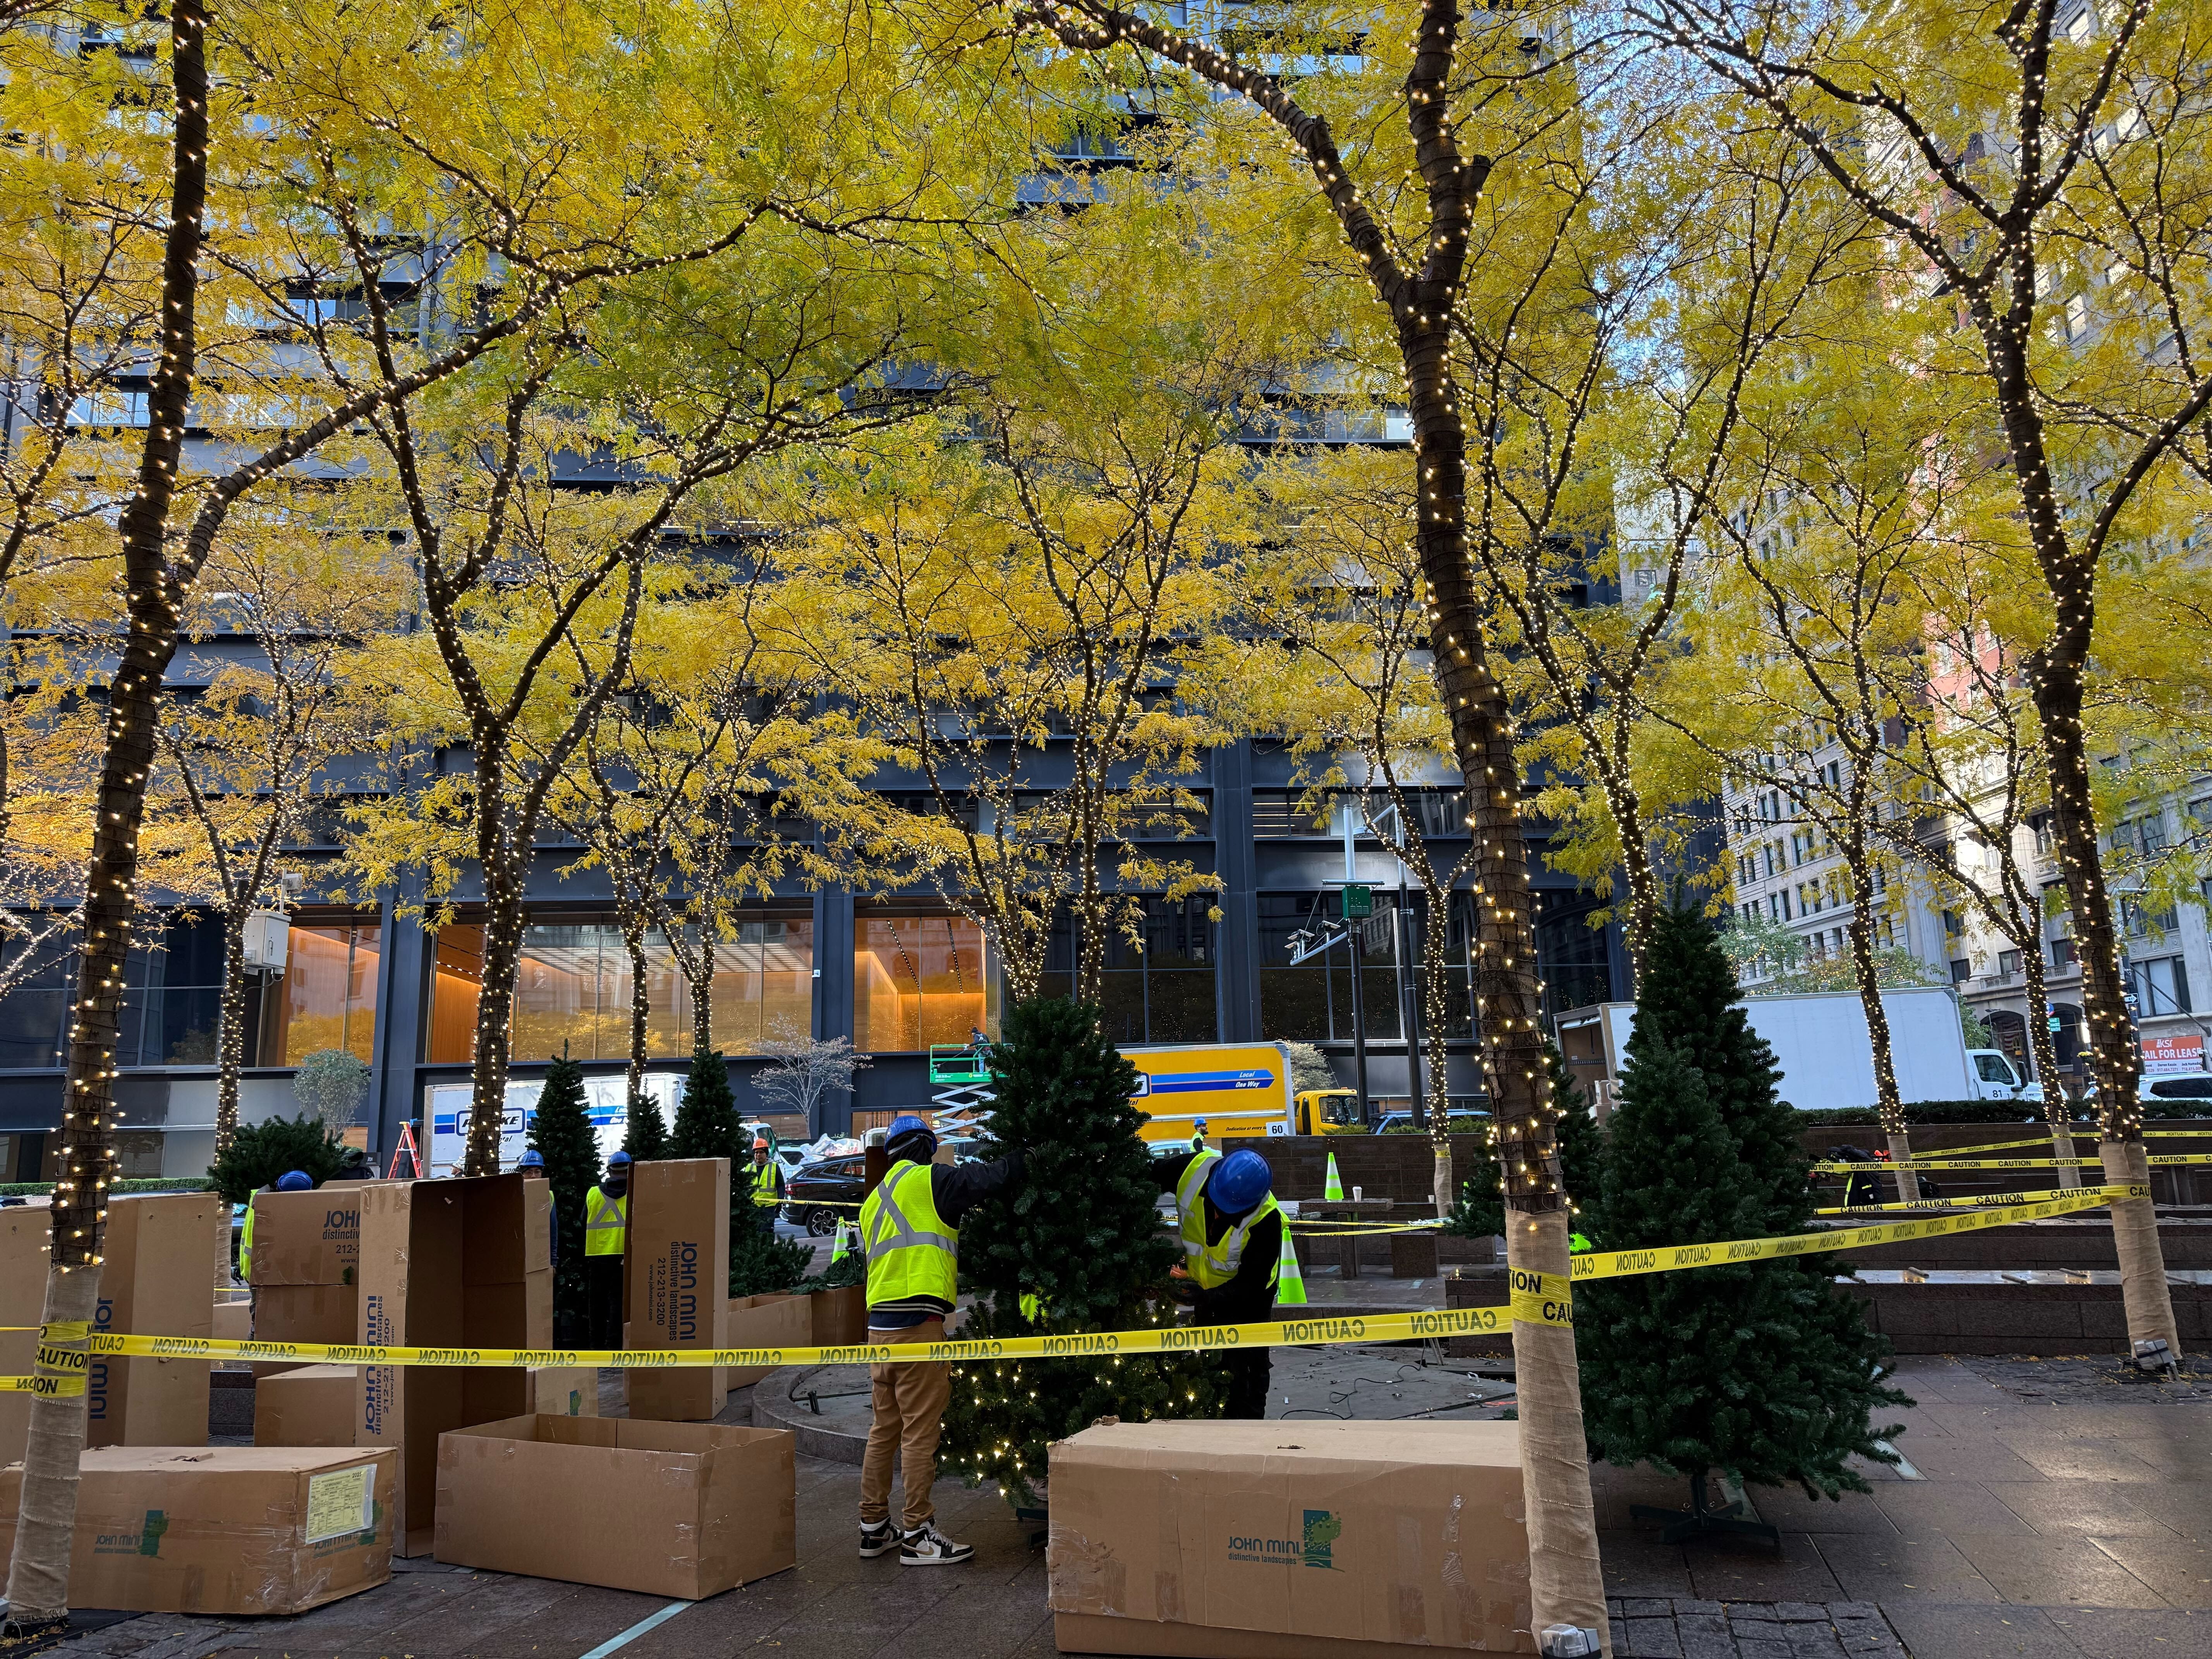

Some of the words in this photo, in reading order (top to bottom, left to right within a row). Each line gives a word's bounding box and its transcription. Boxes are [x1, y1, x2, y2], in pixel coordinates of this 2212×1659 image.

[2143, 1050, 2157, 1059] AIL
[2159, 1049, 2176, 1059] FOR
[2177, 1048, 2202, 1058] LEASE
[1272, 1125, 1283, 1134] 60
[1906, 1199, 1952, 1209] CAUTION
[1976, 1193, 2025, 1205] CAUTION
[2050, 1188, 2102, 1200] CAUTION
[323, 1229, 360, 1240] distinctiv
[670, 1242, 680, 1287] distinctive
[681, 1242, 697, 1289] JOHN
[657, 1258, 666, 1326] 212-213-3200
[94, 1297, 113, 1357] JOH
[667, 1290, 679, 1341] landscapes
[680, 1295, 696, 1340] MINI
[90, 1364, 108, 1419] MINI
[366, 1366, 375, 1434] JOHN
[96, 1535, 117, 1545] JOHN
[1228, 1537, 1262, 1551] JOHN
[1267, 1540, 1300, 1554] MINI
[1228, 1552, 1260, 1562] distinctive
[1262, 1554, 1297, 1566] landscapes
